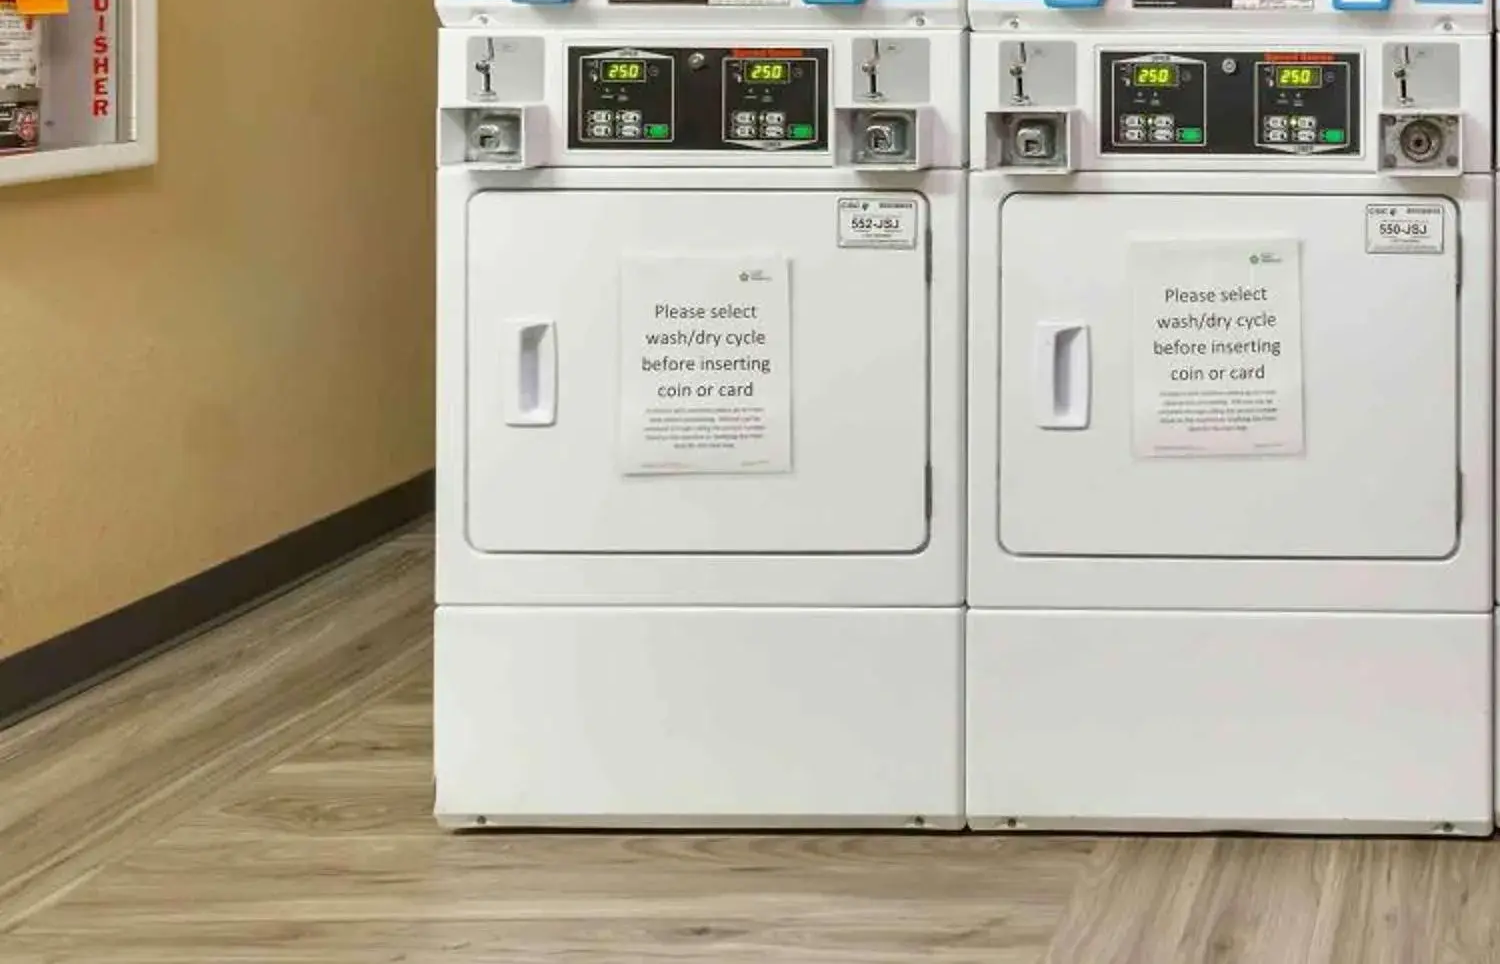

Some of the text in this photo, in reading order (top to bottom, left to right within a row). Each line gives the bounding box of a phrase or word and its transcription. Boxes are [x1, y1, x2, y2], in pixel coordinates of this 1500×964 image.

[1165, 287, 1268, 303] Please select
[655, 304, 757, 319] Please select
[1157, 312, 1276, 330] wash/dry cycle
[645, 330, 766, 347] wash/dry cycle
[1153, 338, 1281, 356] before inserting
[642, 356, 771, 373] before inserting
[1171, 365, 1265, 381] coin or card
[658, 382, 753, 397] coin or card
